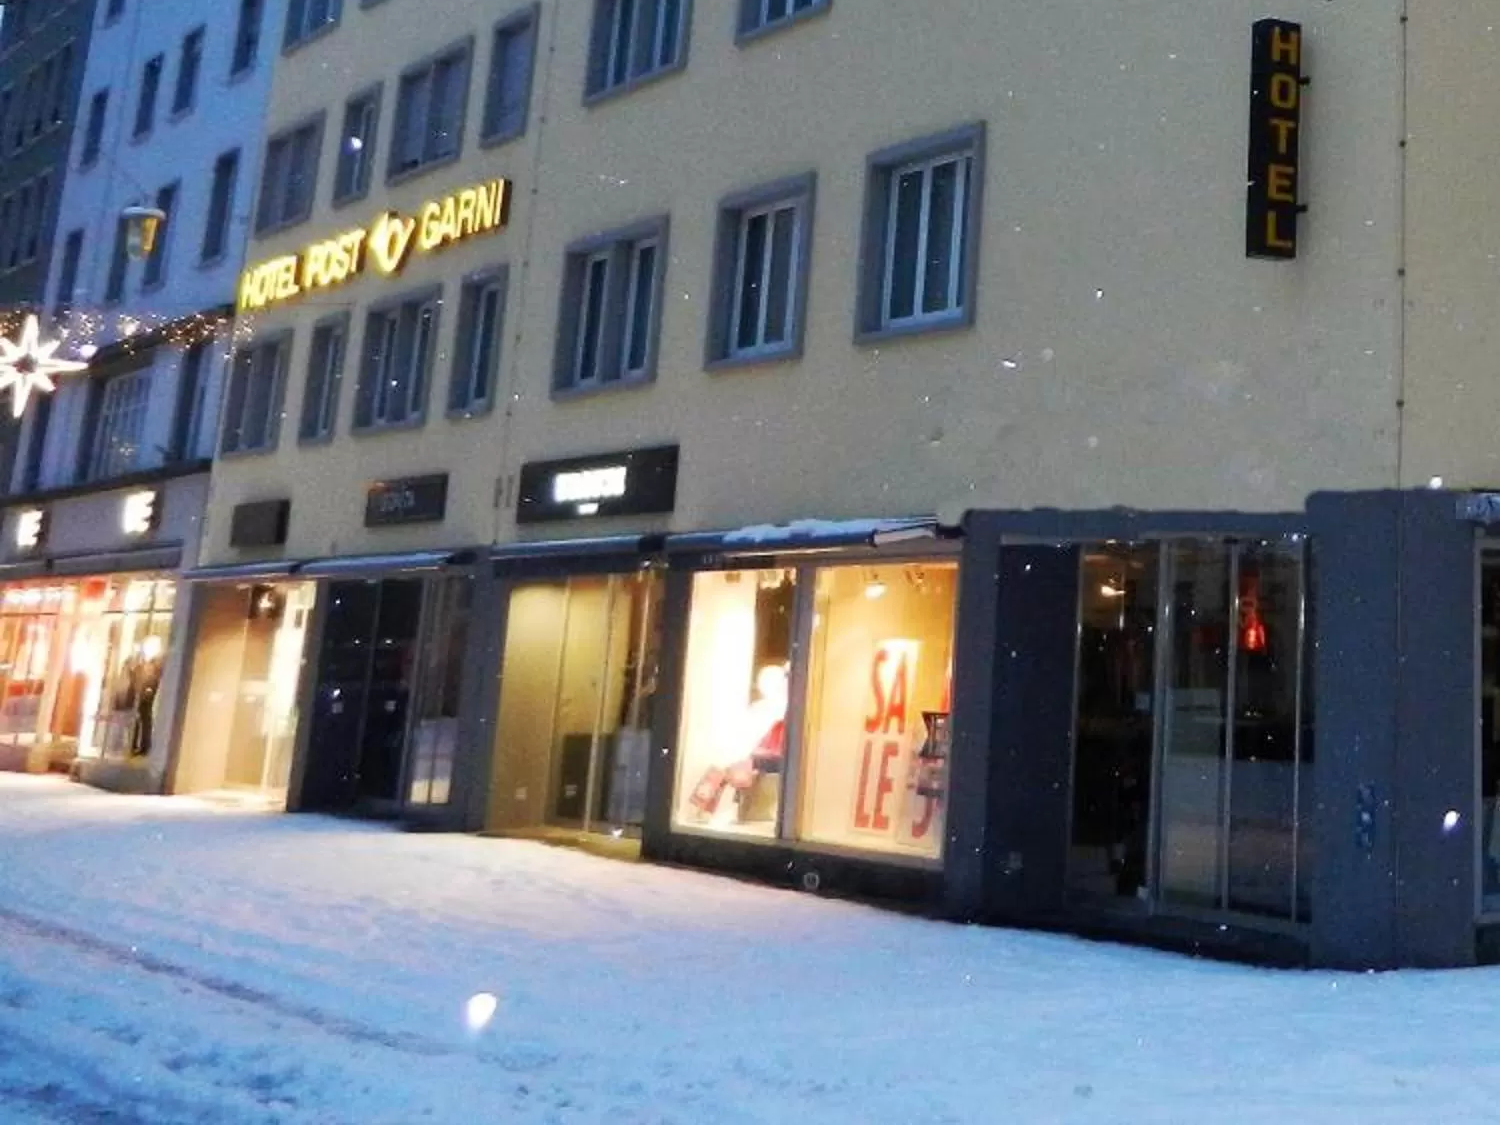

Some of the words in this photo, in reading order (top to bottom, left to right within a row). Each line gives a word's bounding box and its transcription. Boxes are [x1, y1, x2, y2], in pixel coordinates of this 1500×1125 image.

[1265, 26, 1300, 249] HOTEL
[240, 254, 301, 311] HOTEL
[303, 227, 367, 288] POST
[418, 177, 506, 251] GARNI
